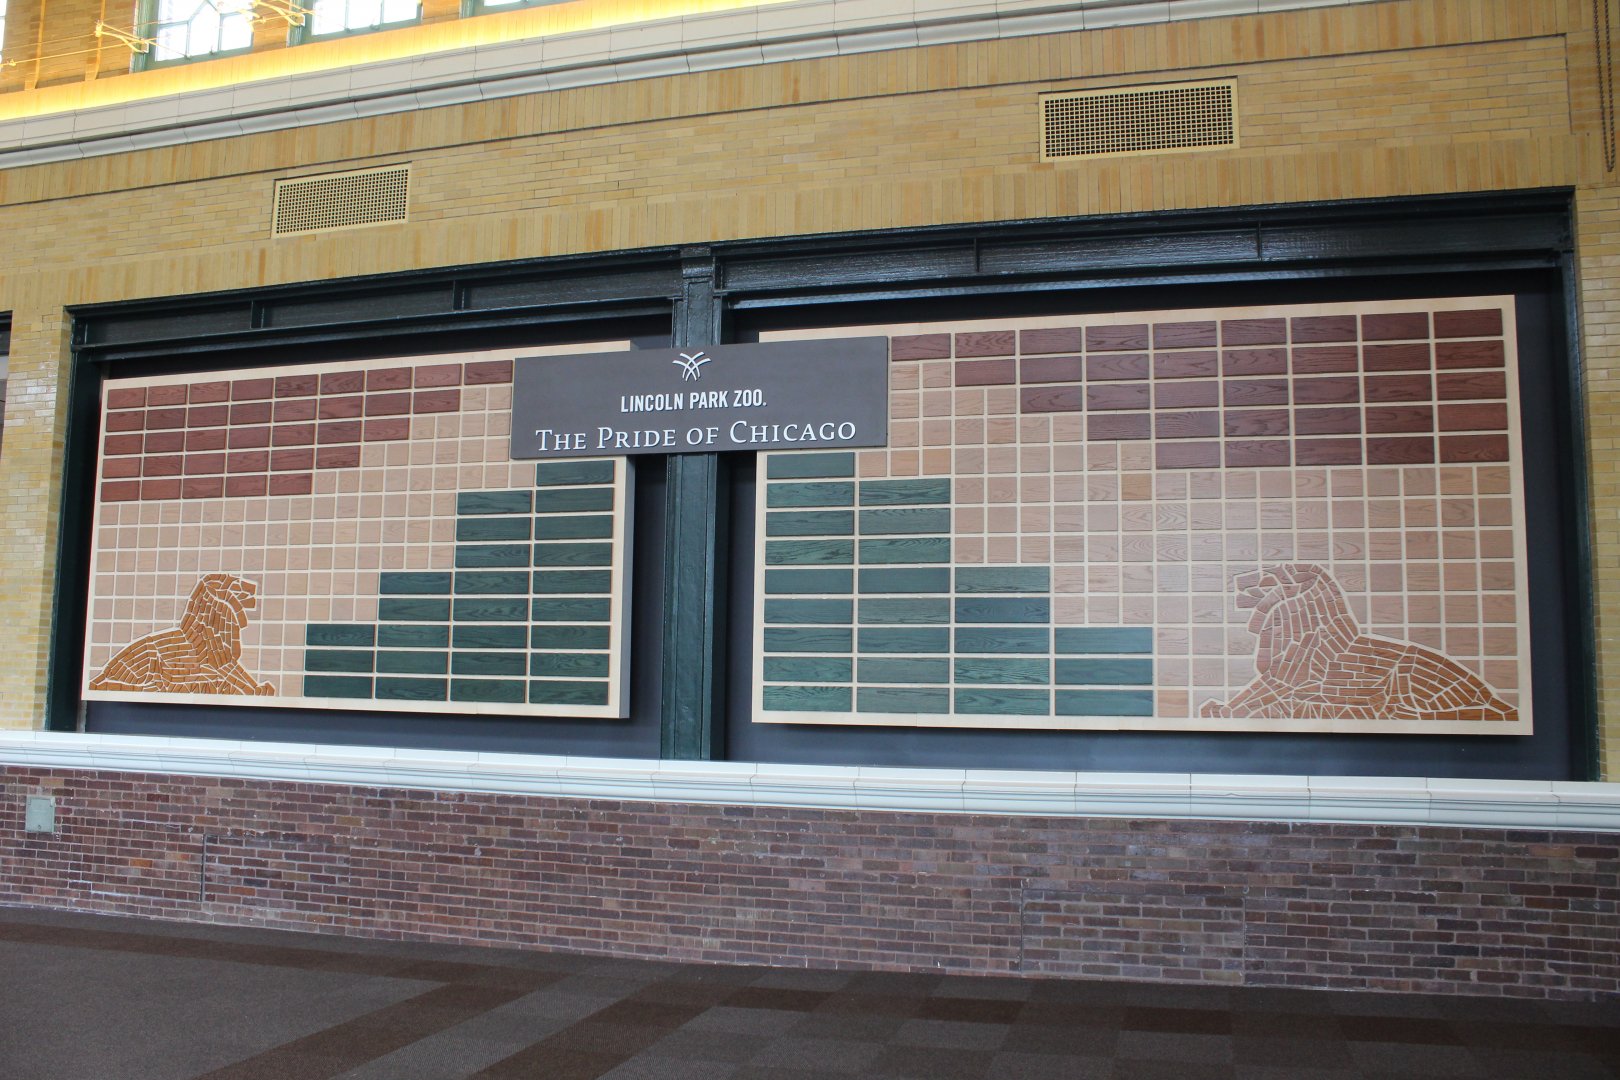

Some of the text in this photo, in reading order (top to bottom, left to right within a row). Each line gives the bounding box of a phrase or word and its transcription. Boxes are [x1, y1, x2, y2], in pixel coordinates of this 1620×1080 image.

[620, 393, 684, 413] LINCOLN
[689, 390, 729, 410] PARK
[535, 420, 857, 452] THE PRIDE OF CHICAGO
